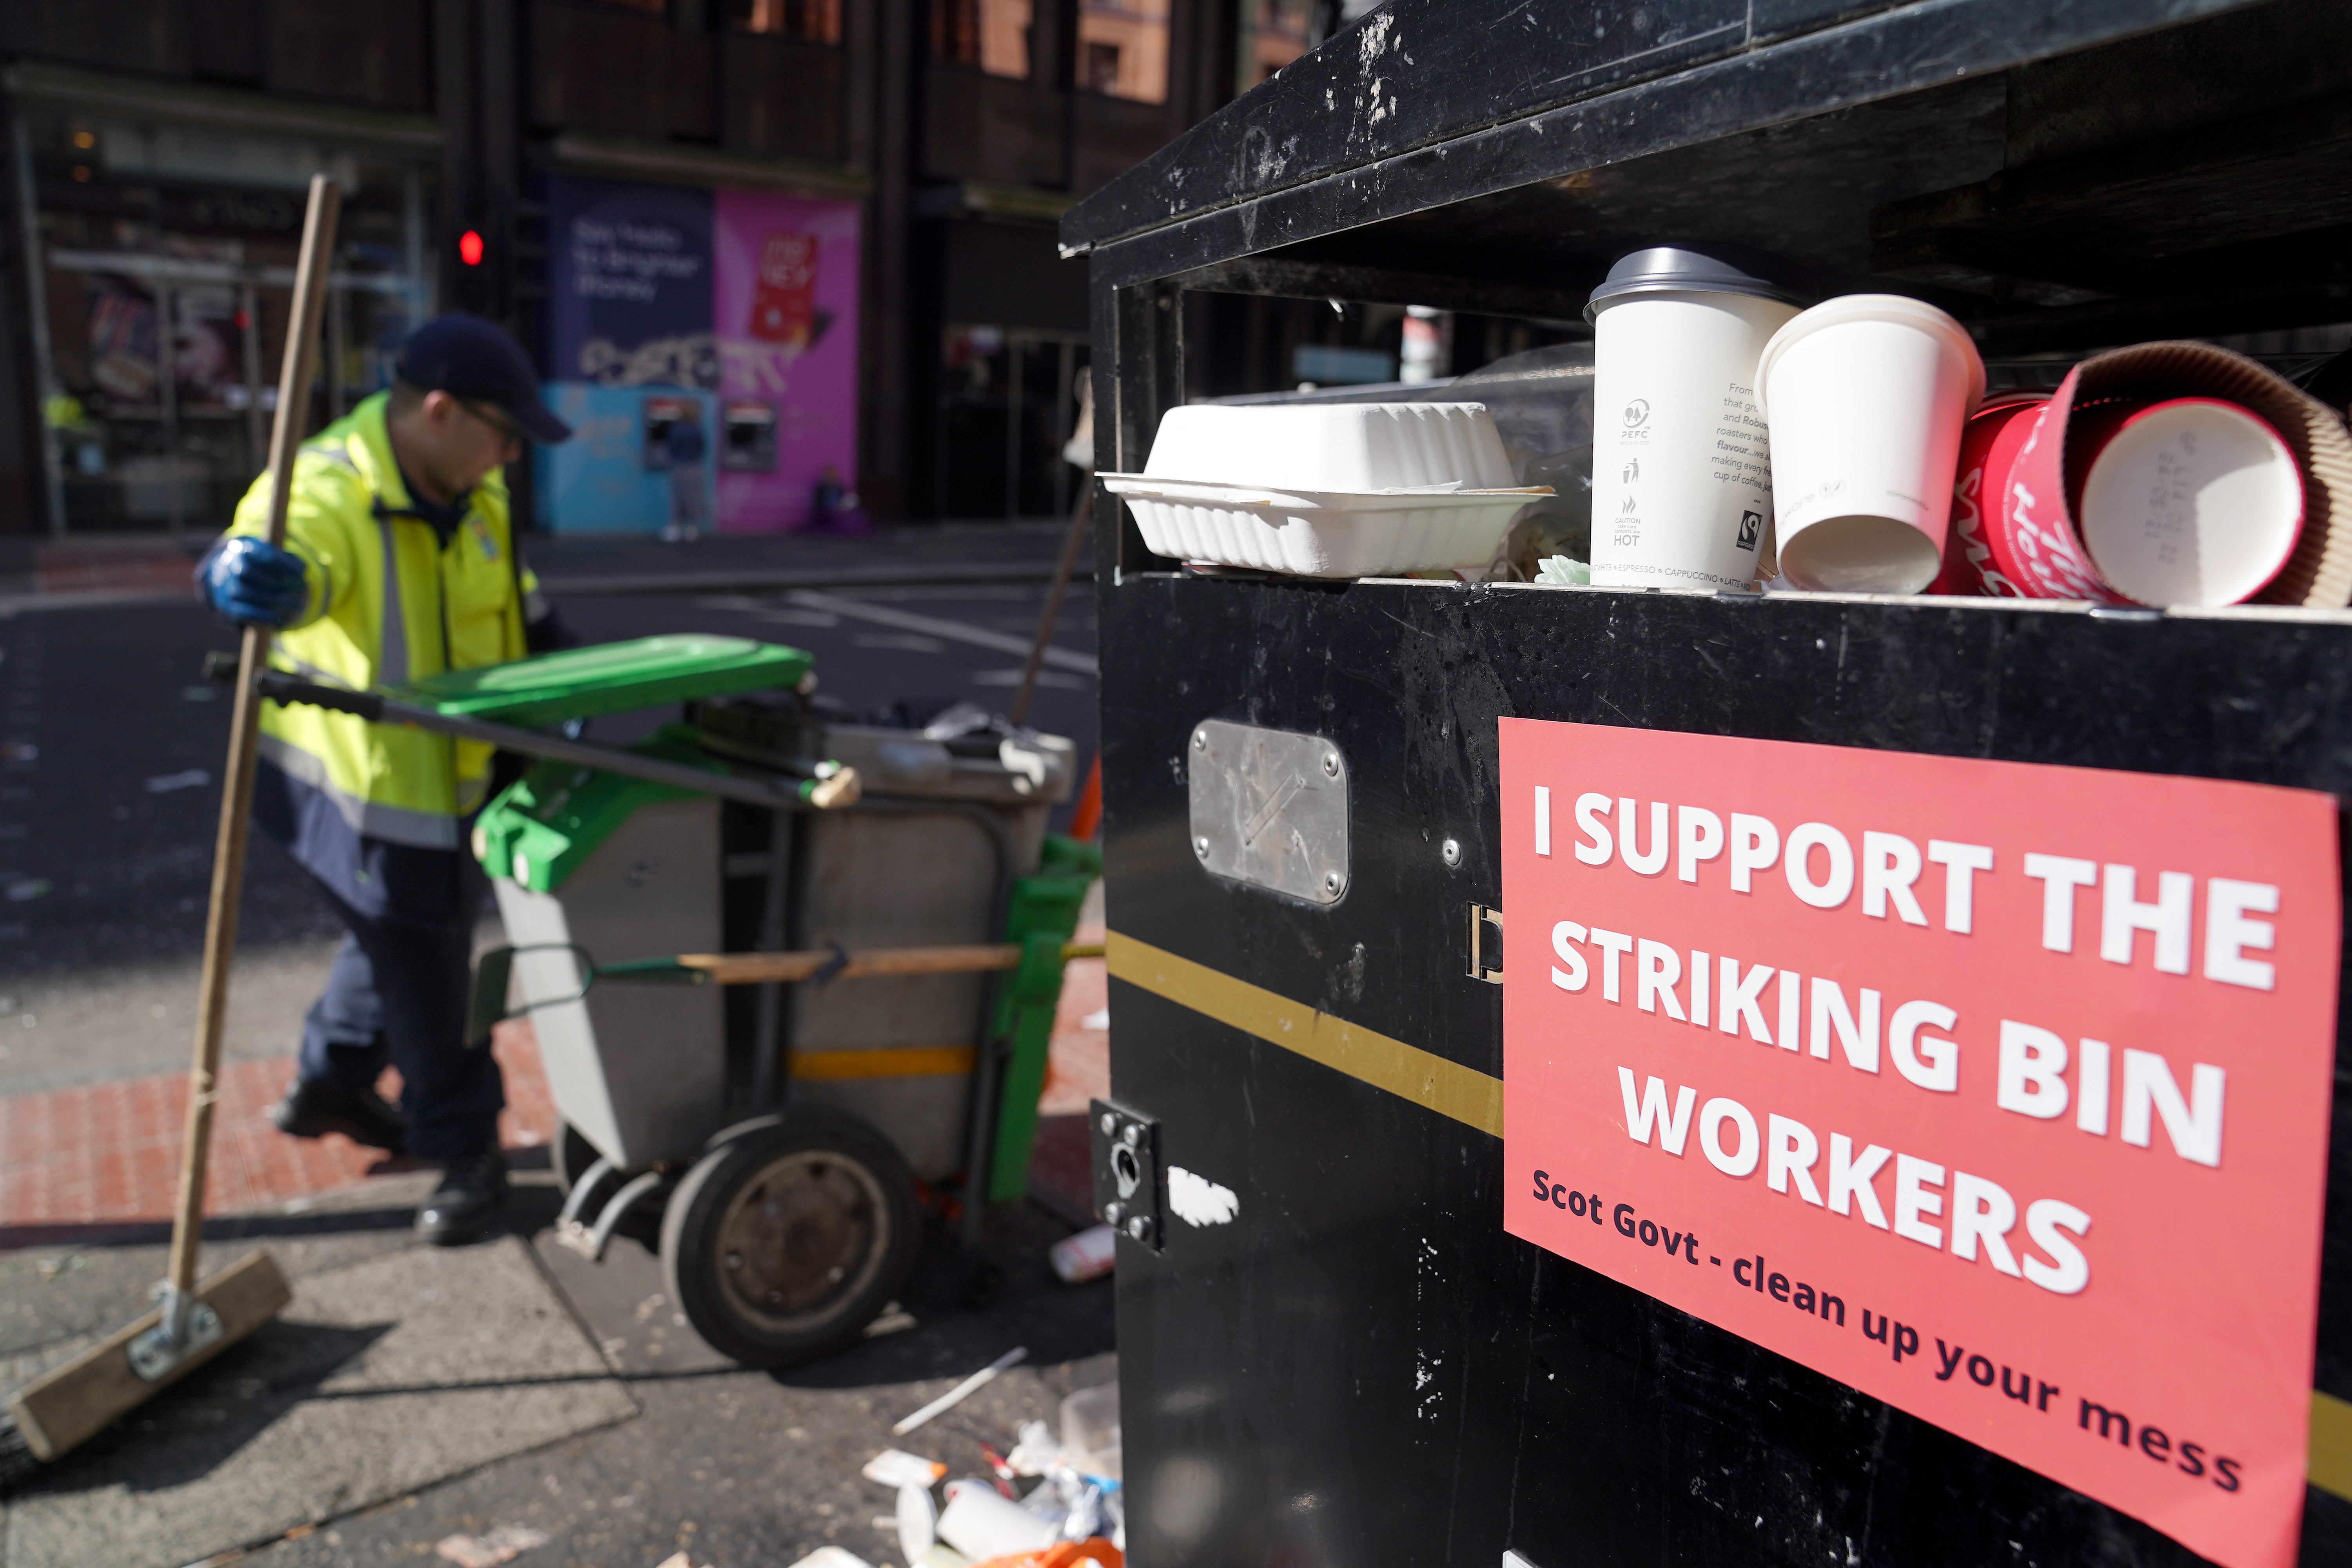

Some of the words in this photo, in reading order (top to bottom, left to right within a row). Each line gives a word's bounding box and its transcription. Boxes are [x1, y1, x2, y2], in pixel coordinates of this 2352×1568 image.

[1729, 383, 1753, 396] From
[1724, 397, 1742, 408] that
[1723, 414, 1740, 423] and
[1743, 416, 1769, 430] Robus
[1622, 430, 1648, 439] PEFC
[1717, 428, 1751, 440] roasters
[1753, 434, 1767, 445] who
[1711, 456, 1742, 470] making
[1744, 463, 1763, 475] every
[1714, 472, 1729, 483] cup
[1731, 474, 1740, 482] of
[1741, 477, 1763, 490] coffee,
[1614, 534, 1640, 546] HOT
[1737, 541, 1754, 550] FAIRTRADE
[1618, 564, 1655, 573] ESPRESSO
[1665, 568, 1717, 583] CAPPUCCINO
[1724, 577, 1740, 588] LATTE
[1535, 785, 1550, 856] I
[1575, 792, 1993, 934] SUPPORT
[2023, 852, 2279, 990] THE
[1552, 920, 1959, 1092] STRIKING
[1996, 1019, 2226, 1167] BIN
[1617, 1065, 2091, 1294] WORKERS
[1533, 1170, 1602, 1225] Scot
[1613, 1203, 1699, 1265] Govt
[1733, 1256, 1845, 1327] clean
[1863, 1309, 1919, 1363] up
[1935, 1339, 2060, 1412] your
[2079, 1398, 2242, 1493] mess
